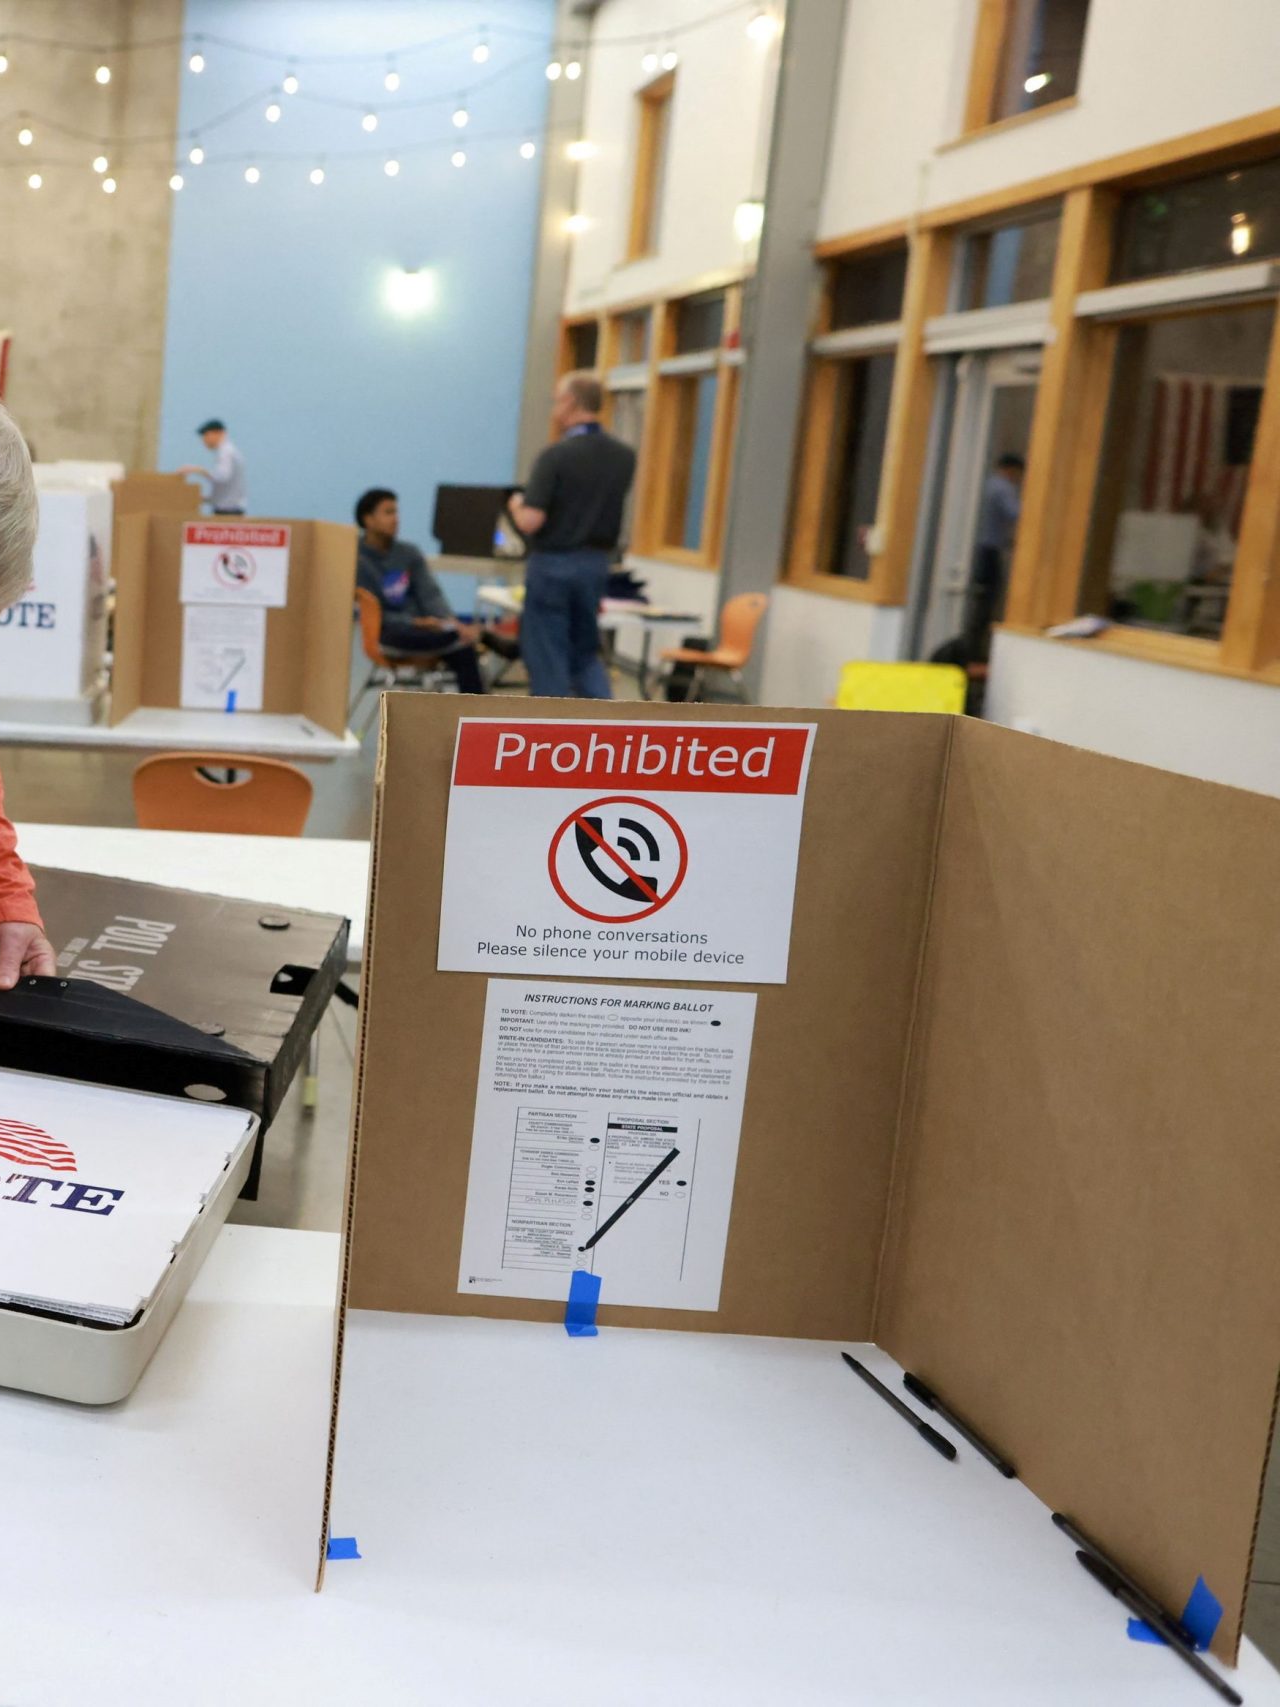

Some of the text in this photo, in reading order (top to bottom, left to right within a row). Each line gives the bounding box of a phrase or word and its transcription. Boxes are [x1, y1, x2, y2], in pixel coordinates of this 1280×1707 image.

[493, 732, 775, 778] Prohibited
[91, 915, 176, 955] POLL
[516, 925, 708, 945] No phone conversations
[477, 942, 744, 965] Please silence your mobile device
[524, 994, 714, 1012] INSTRUCTIONS FOR MARKING BALLOT
